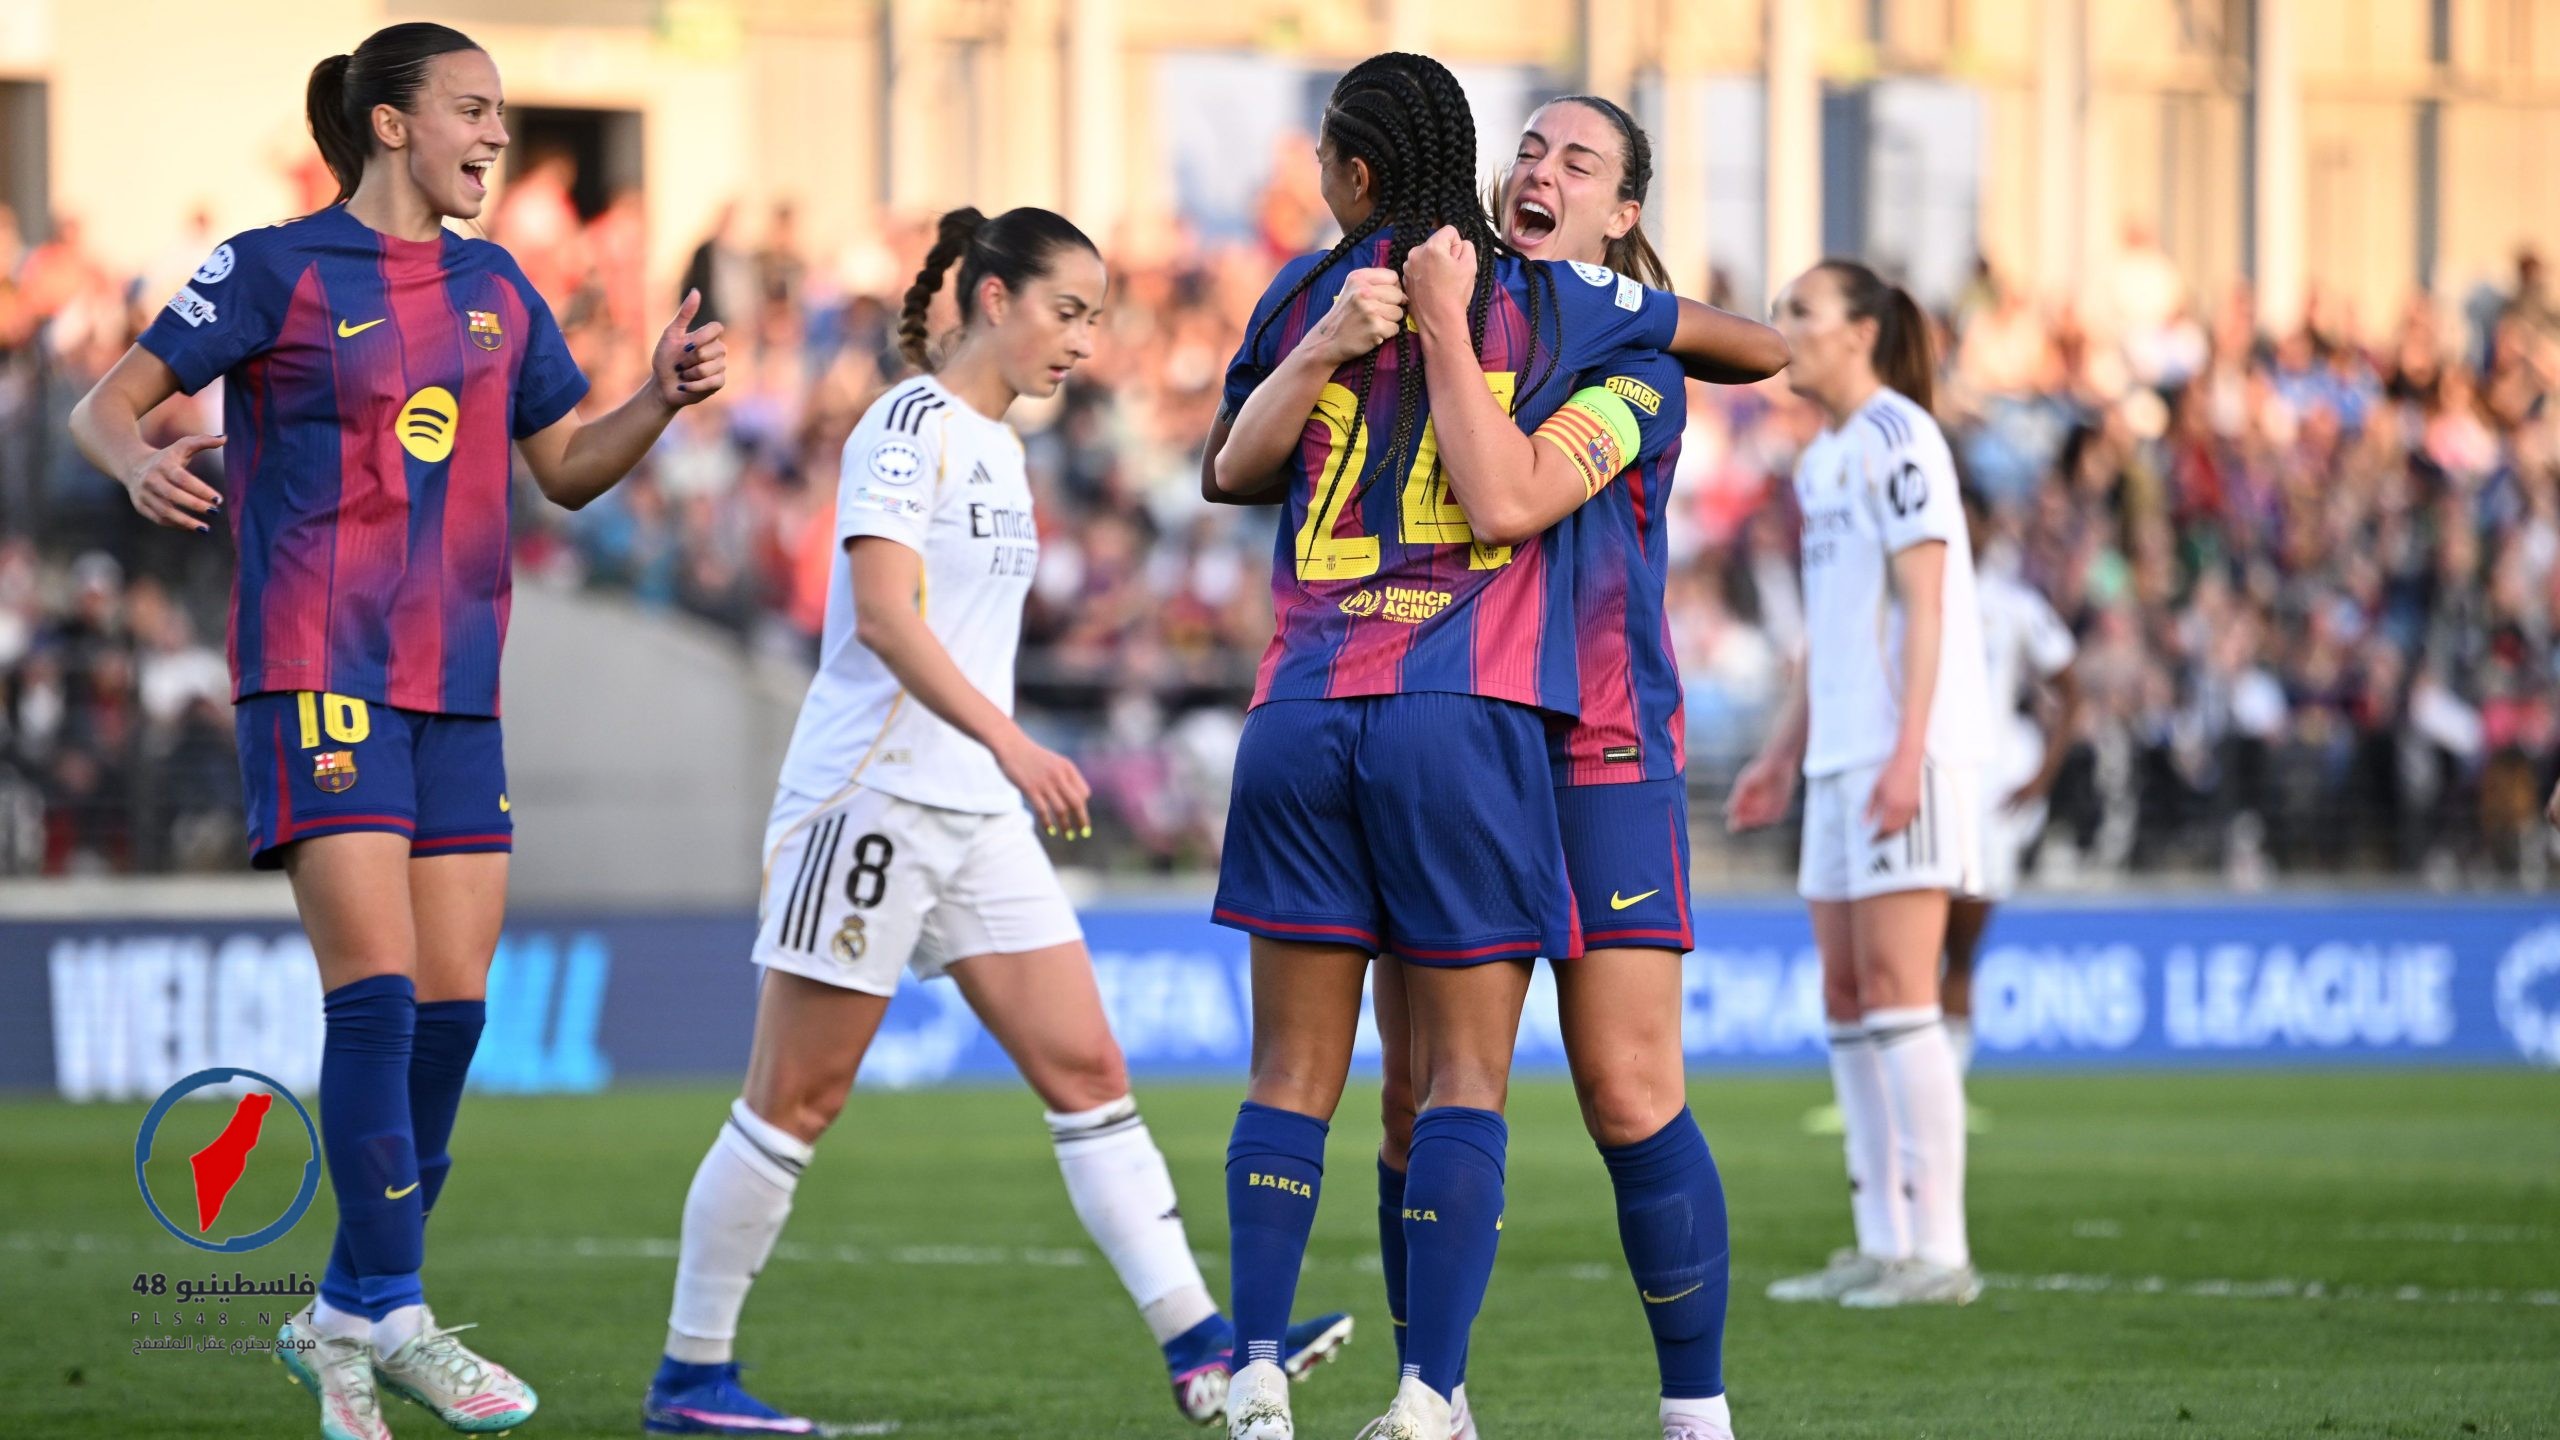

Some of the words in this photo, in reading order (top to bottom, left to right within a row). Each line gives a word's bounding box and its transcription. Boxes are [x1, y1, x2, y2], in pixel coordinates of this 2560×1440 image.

[1605, 377, 1660, 413] BIMBO
[968, 502, 1035, 540] Emira
[1385, 586, 1452, 607] UNHCR
[846, 833, 893, 908] 8
[2164, 942, 2455, 1051] LEAGUE
[1249, 1172, 1311, 1199] BARÇA
[1402, 1208, 1437, 1222] RÇA
